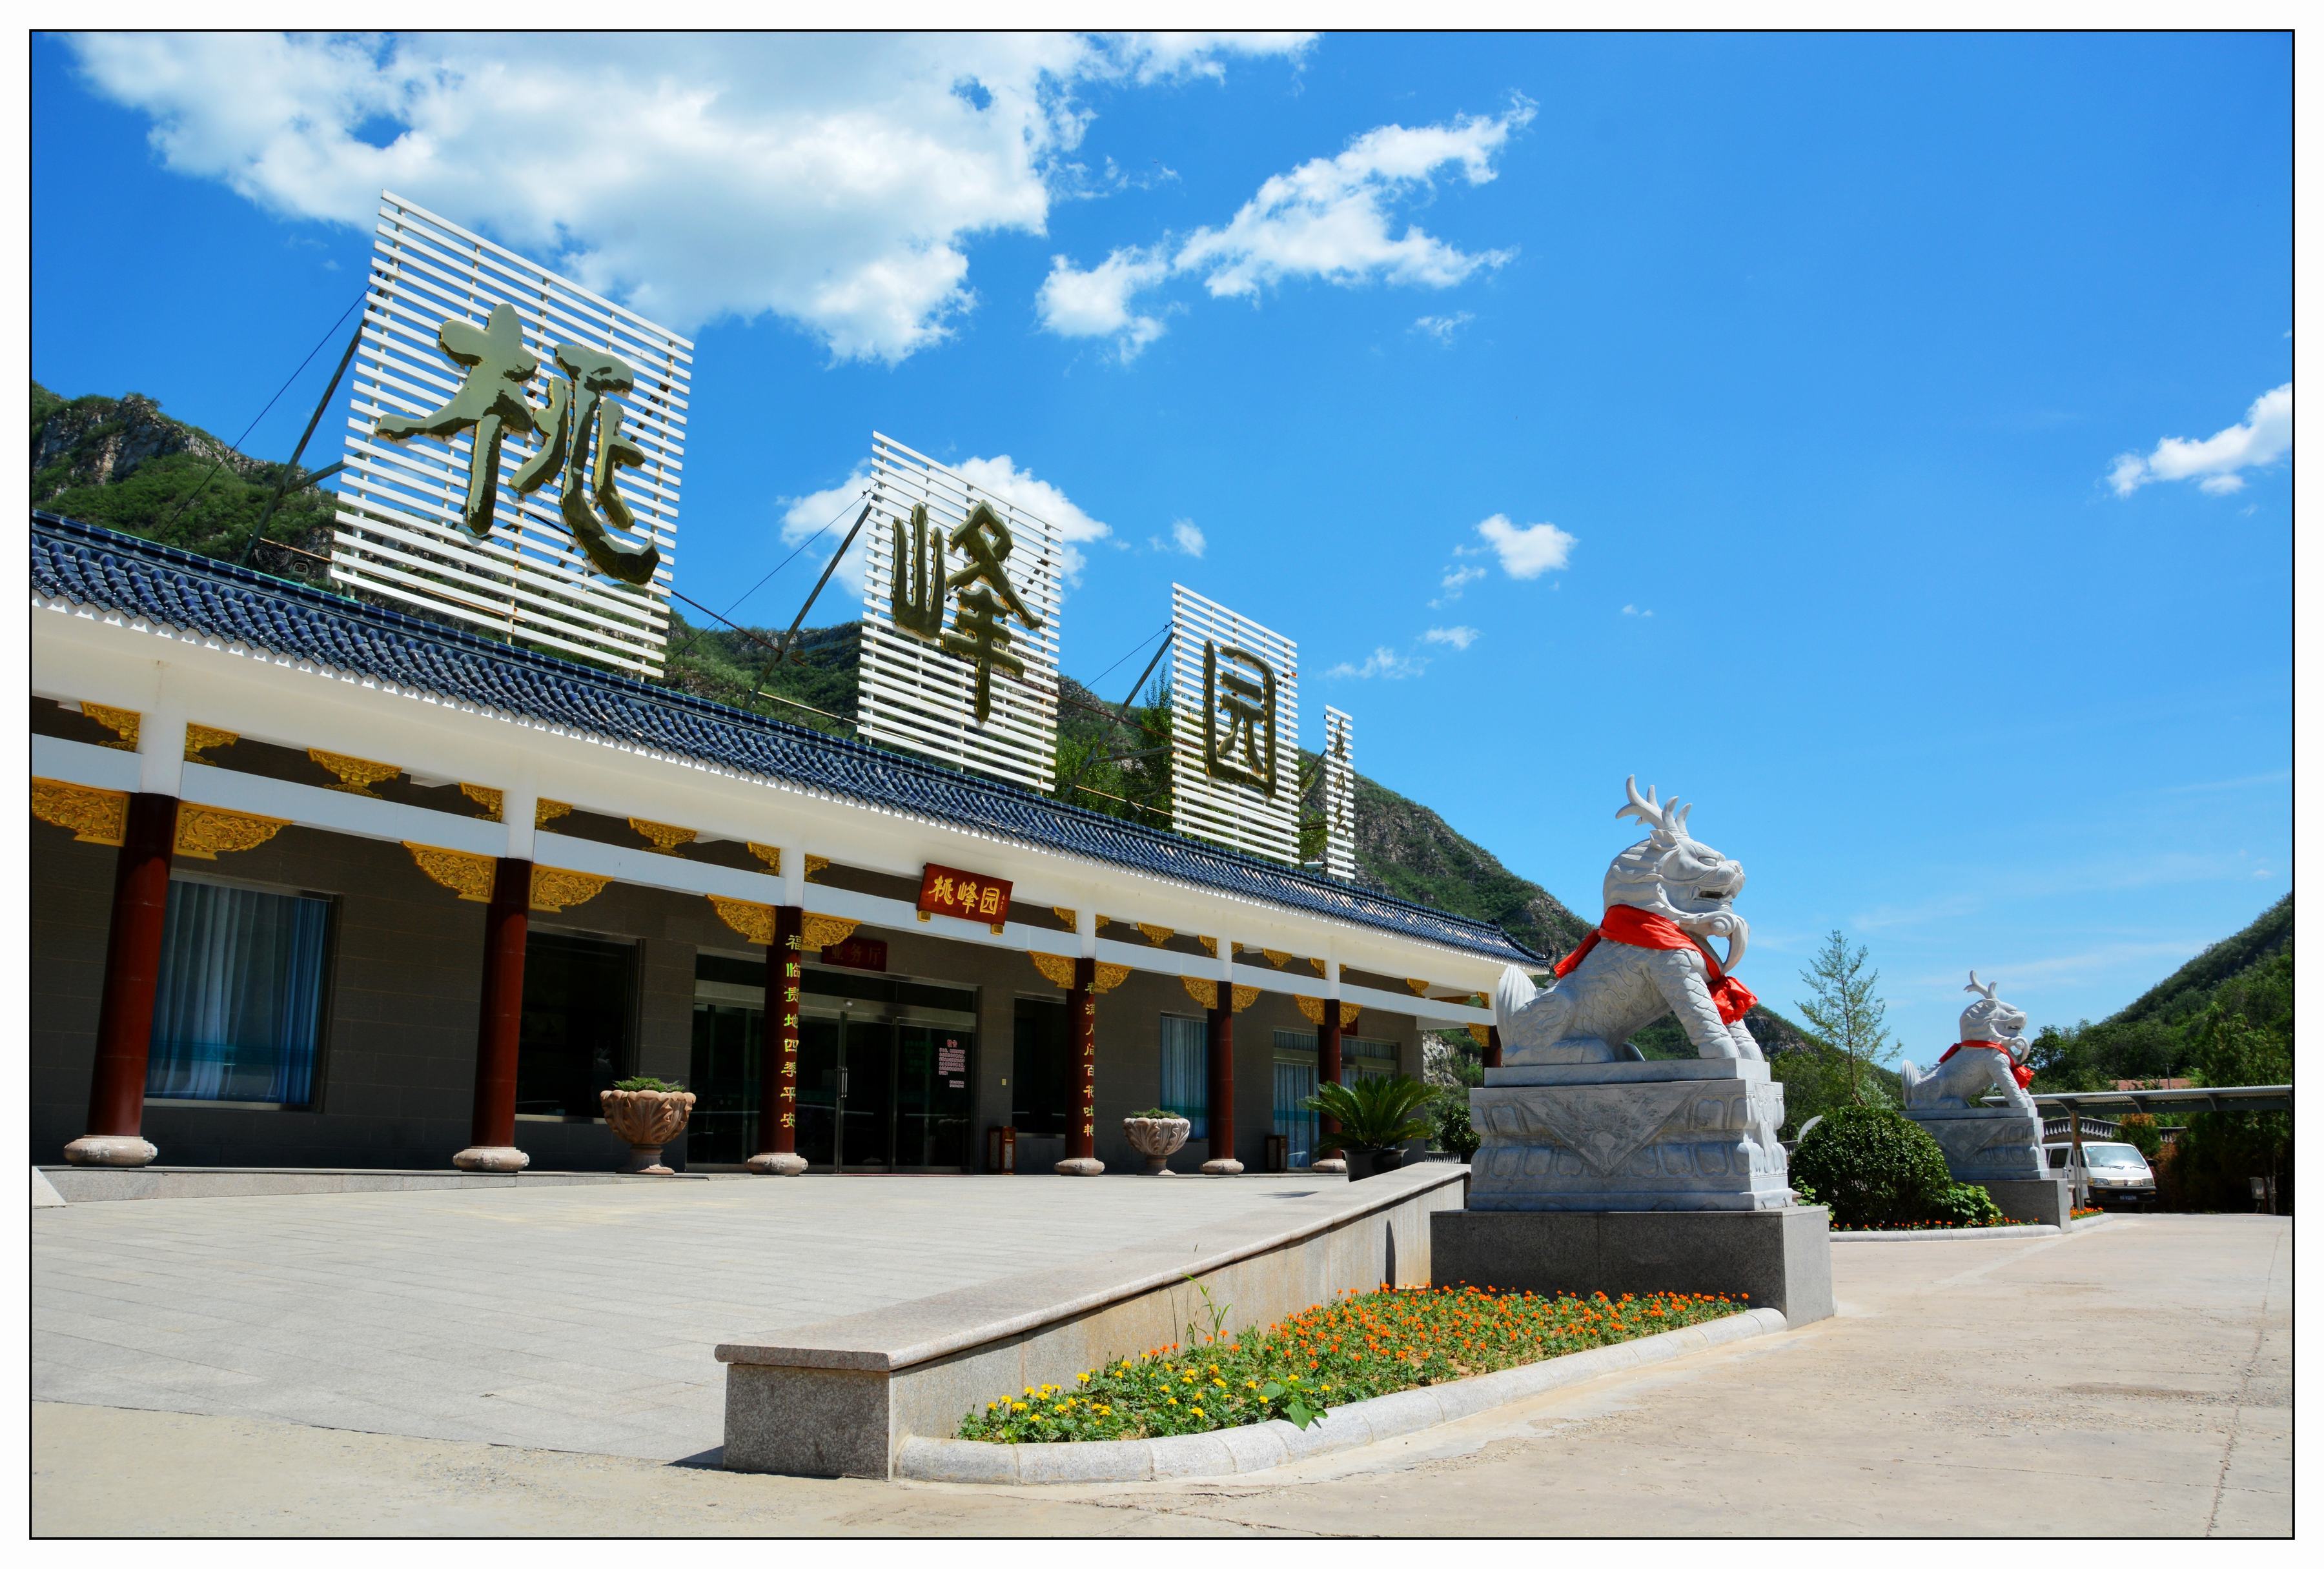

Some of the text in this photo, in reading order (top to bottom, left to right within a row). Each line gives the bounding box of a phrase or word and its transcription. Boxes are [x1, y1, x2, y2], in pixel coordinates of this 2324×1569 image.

[928, 875, 1000, 915] 桃峰园
[780, 935, 801, 1128] 福临贵地四季平安
